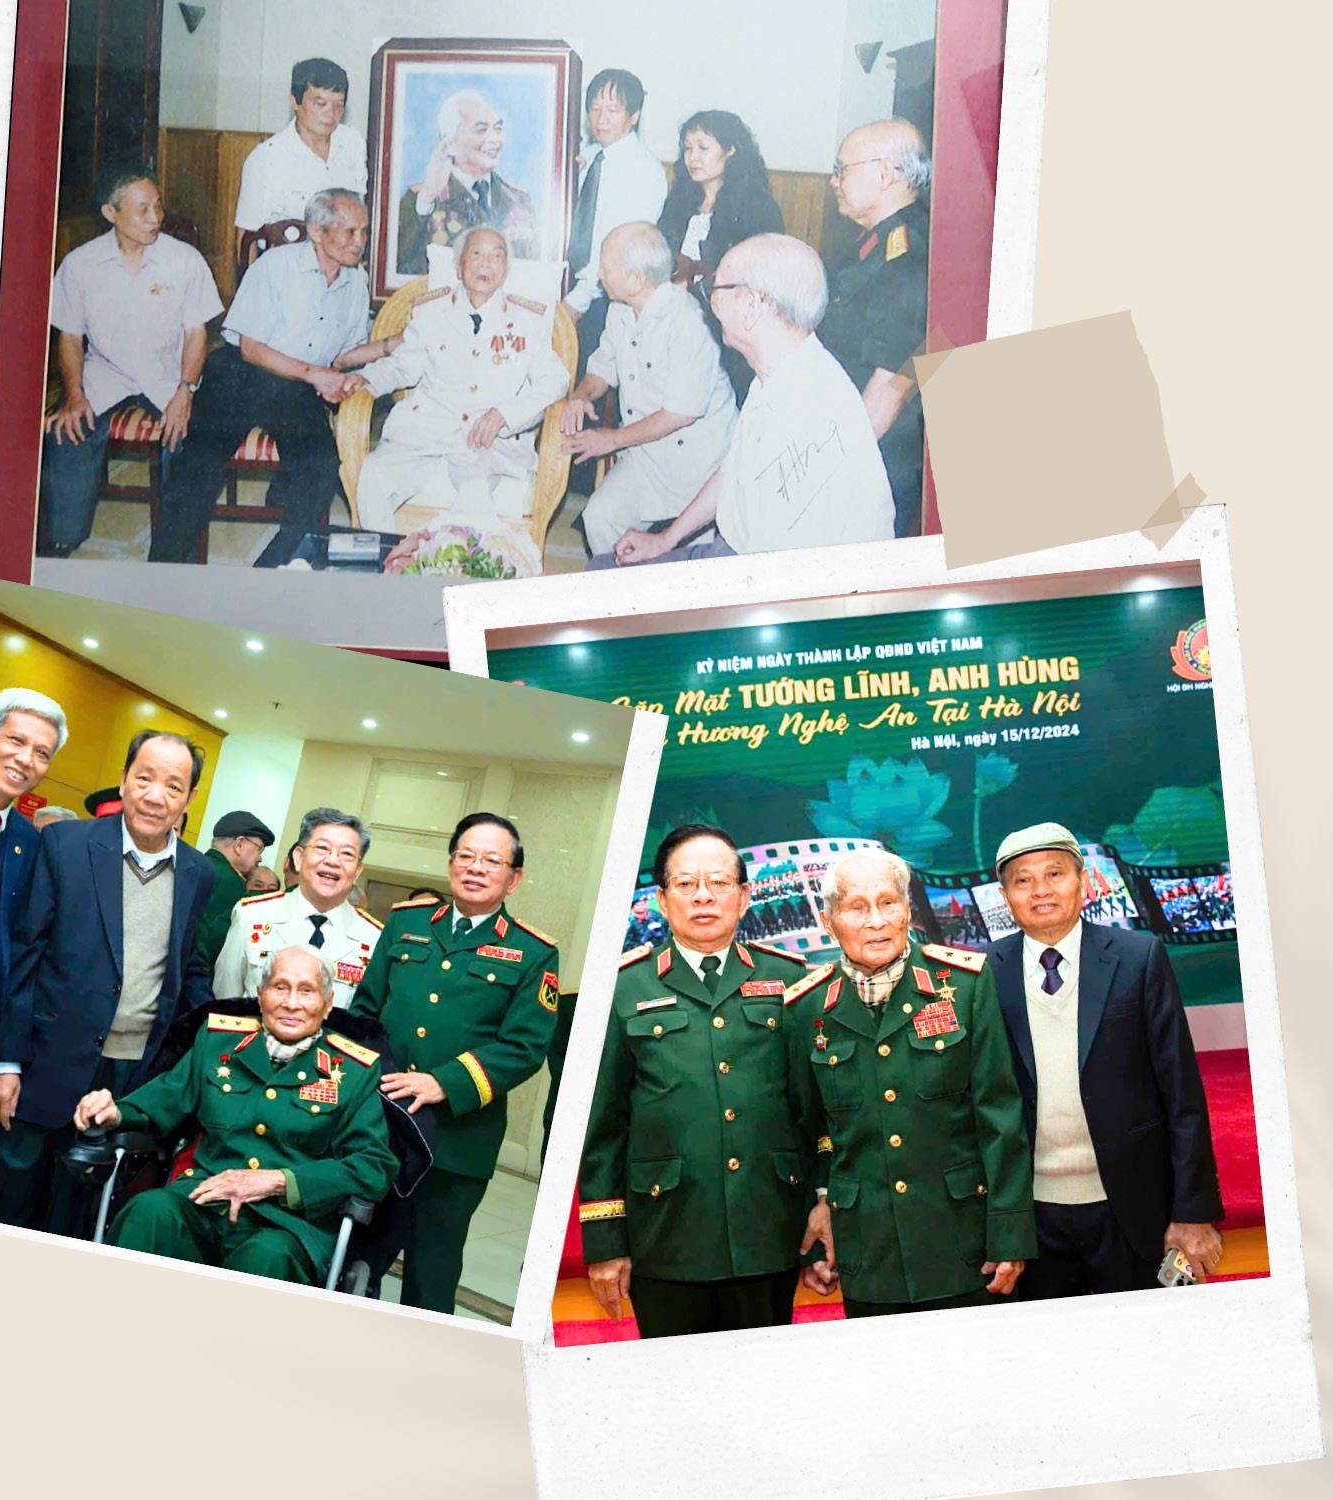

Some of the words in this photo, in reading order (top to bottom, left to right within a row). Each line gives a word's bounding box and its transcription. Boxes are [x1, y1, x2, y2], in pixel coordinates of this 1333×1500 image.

[718, 656, 753, 673] NIỆM
[757, 652, 792, 669] NGÀY
[795, 648, 842, 665] THÀNH
[846, 644, 871, 662] LẬP
[875, 642, 913, 659] QĐND
[917, 637, 948, 656] VIỆT
[951, 636, 983, 651] NAM
[675, 687, 731, 716] Mặt
[738, 676, 836, 709] TƯỚNG
[843, 669, 920, 700] LĨNH,
[928, 663, 990, 693] ANH
[997, 655, 1081, 687] HÙNG
[677, 720, 770, 749] Hương
[778, 709, 850, 745] Nghệ
[858, 702, 918, 729] An
[926, 697, 970, 726] Tại
[978, 694, 1023, 719] Hà
[1032, 689, 1081, 717] Nội
[911, 735, 930, 750] Hà
[934, 734, 961, 750] Nội,
[965, 731, 997, 748] ngày
[1001, 724, 1080, 742] 15/12/2024
